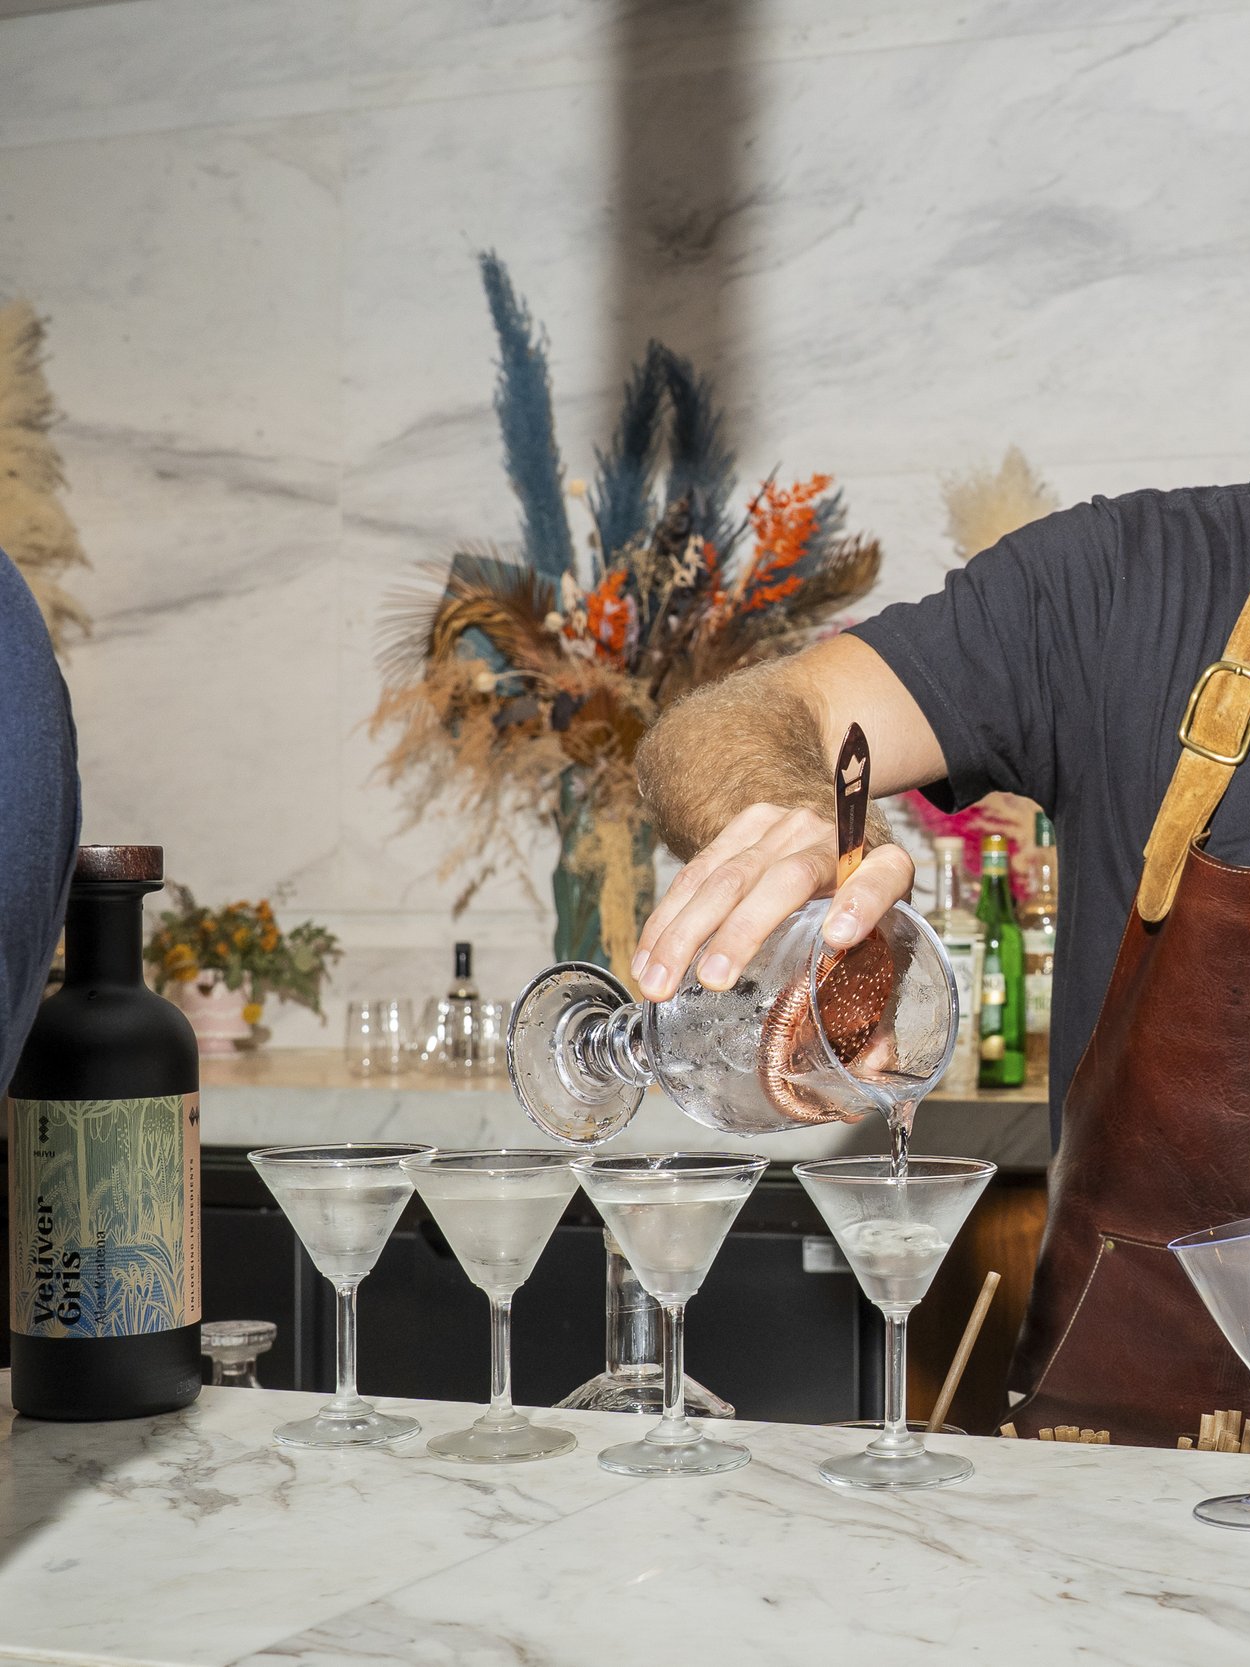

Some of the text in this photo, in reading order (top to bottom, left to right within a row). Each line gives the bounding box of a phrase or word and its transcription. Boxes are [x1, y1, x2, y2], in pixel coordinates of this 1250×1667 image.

[33, 1195, 54, 1325] Vetiver
[55, 1250, 82, 1326] Gris
[95, 1231, 107, 1325] Alex Kratena
